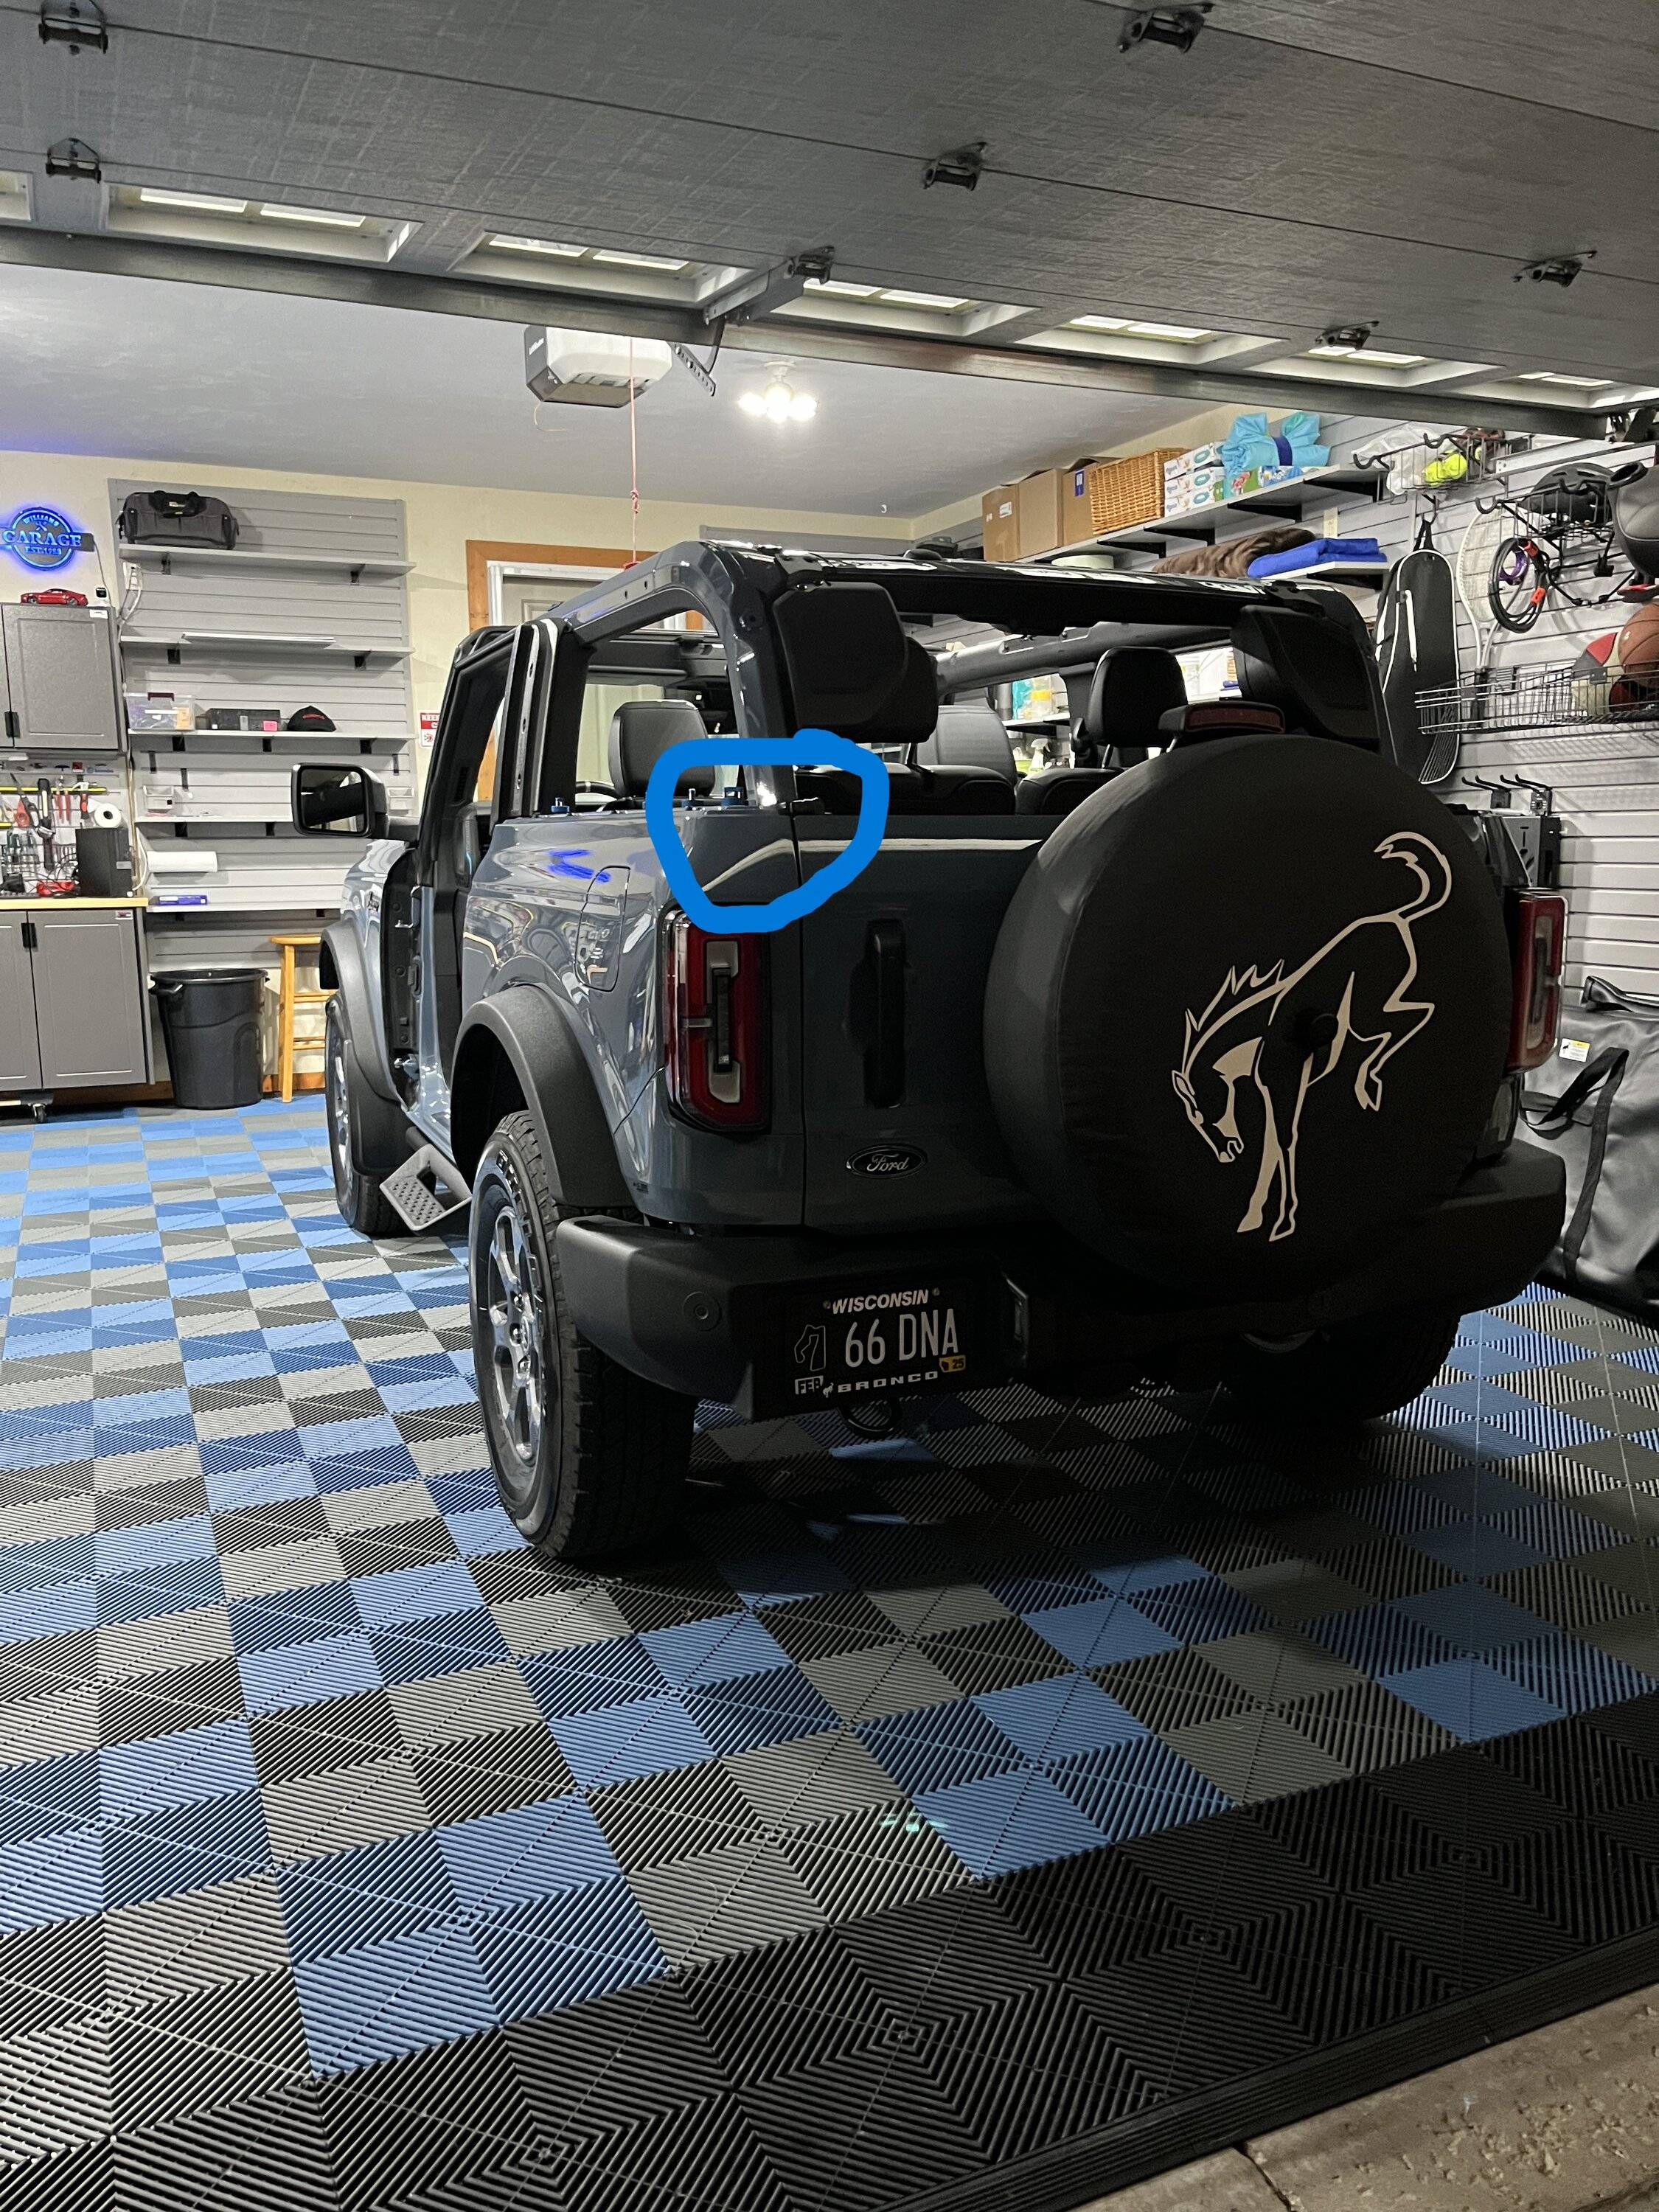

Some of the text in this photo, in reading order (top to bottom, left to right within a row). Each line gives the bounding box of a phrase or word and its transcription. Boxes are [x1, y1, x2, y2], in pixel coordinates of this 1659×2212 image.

[2, 530, 82, 546] GARAGE
[866, 1153, 909, 1172] Ford
[832, 1290, 929, 1314] WISCONSIN
[845, 1308, 959, 1368] 66 DNA
[952, 1357, 964, 1369] 25
[838, 1371, 939, 1393] BRONCO
